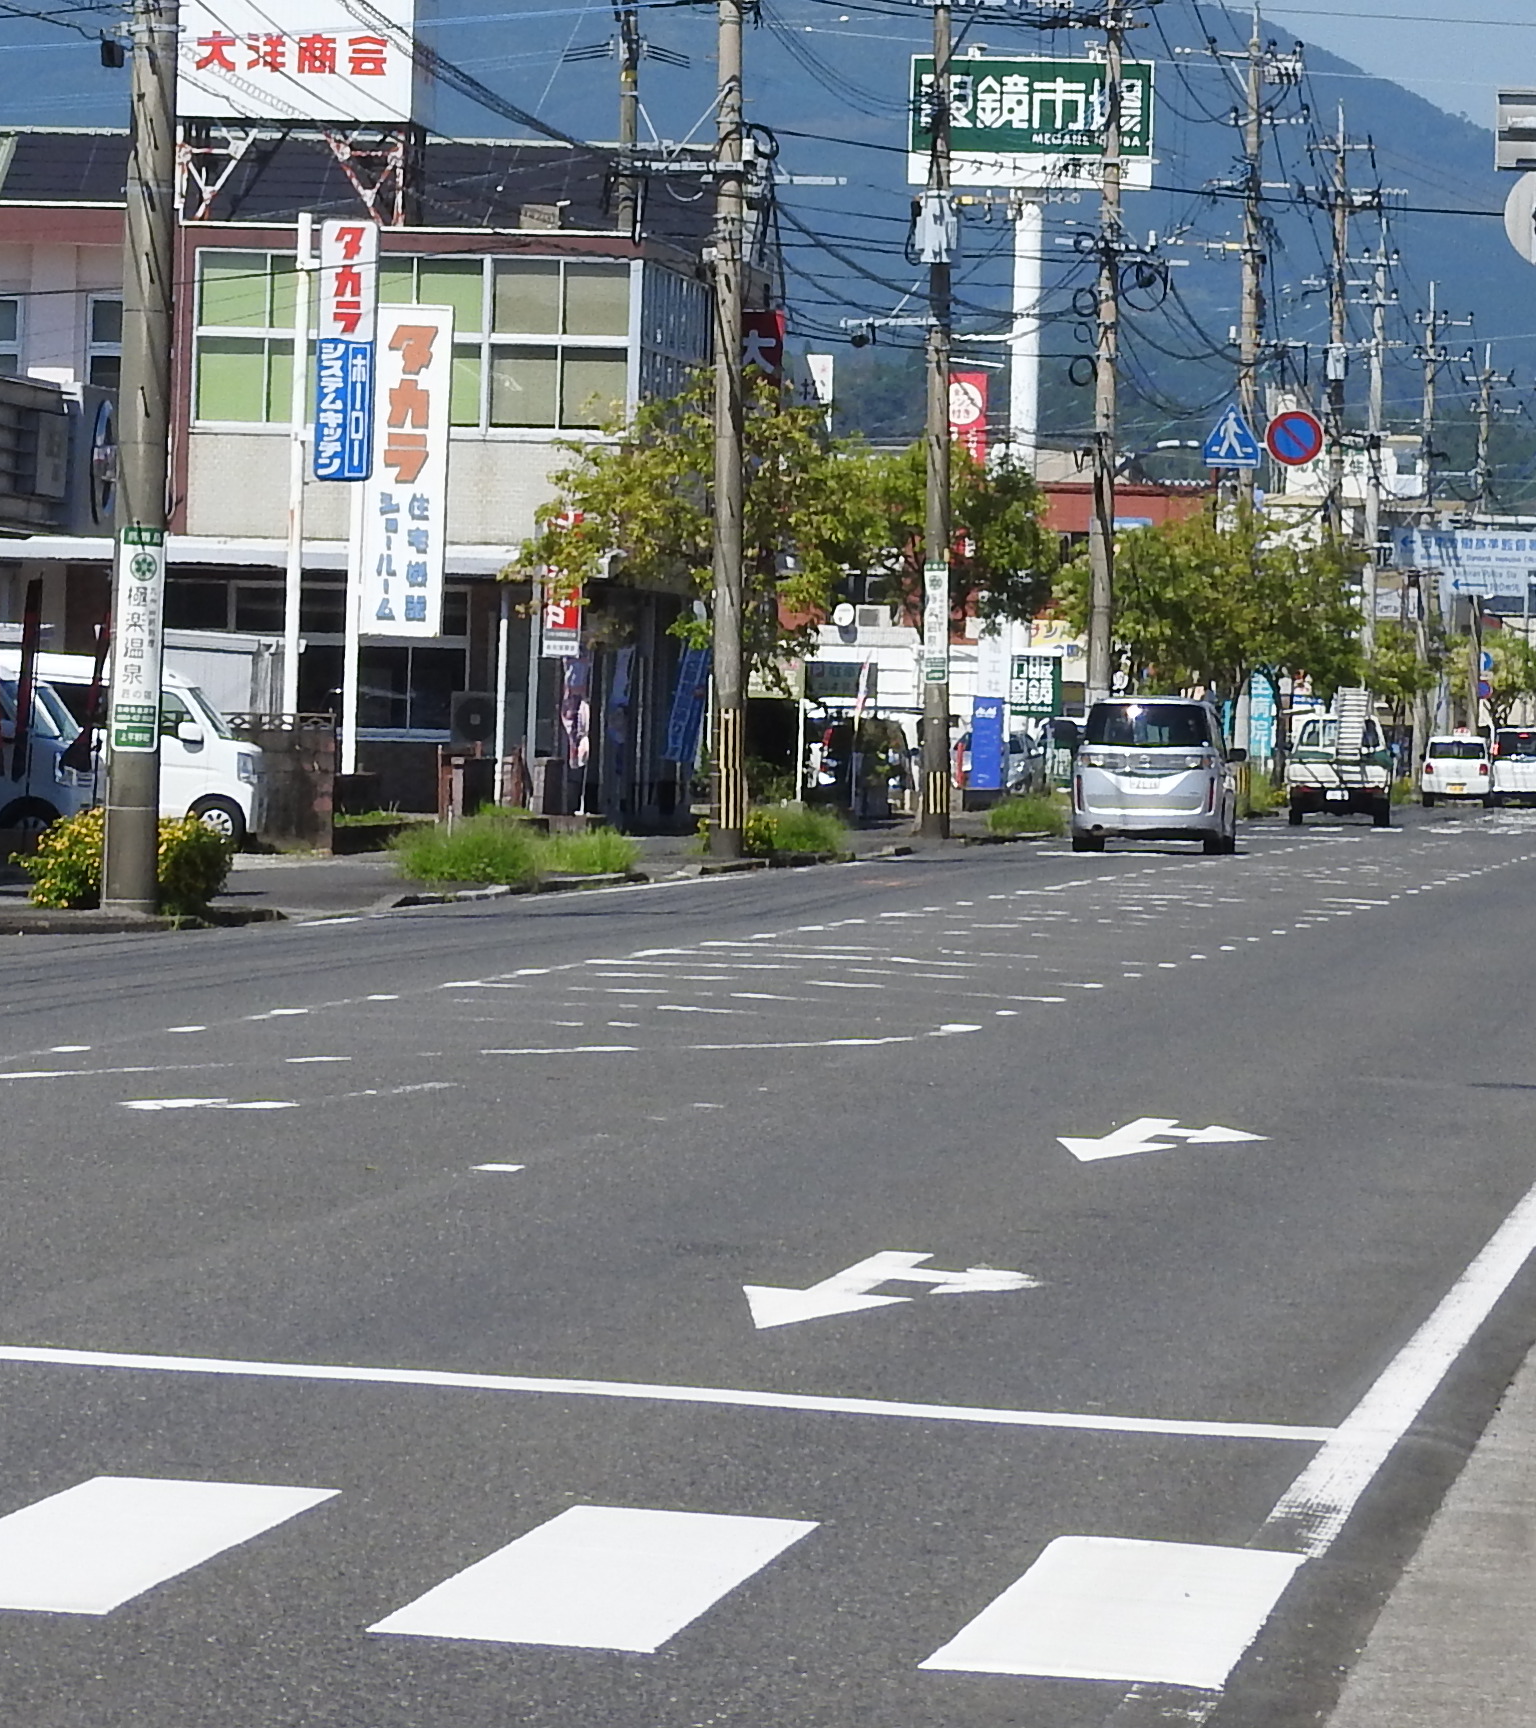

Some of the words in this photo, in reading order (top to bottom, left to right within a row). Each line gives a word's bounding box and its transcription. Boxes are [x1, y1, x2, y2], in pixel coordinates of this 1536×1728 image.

[195, 31, 389, 76] 大洋商会
[333, 227, 366, 334] タカラ
[317, 343, 345, 476] システムキッチン
[352, 353, 366, 467] ホーロー
[384, 325, 439, 485] タカラ
[376, 492, 400, 621] ショールーム
[122, 585, 148, 684] 極楽温泉
